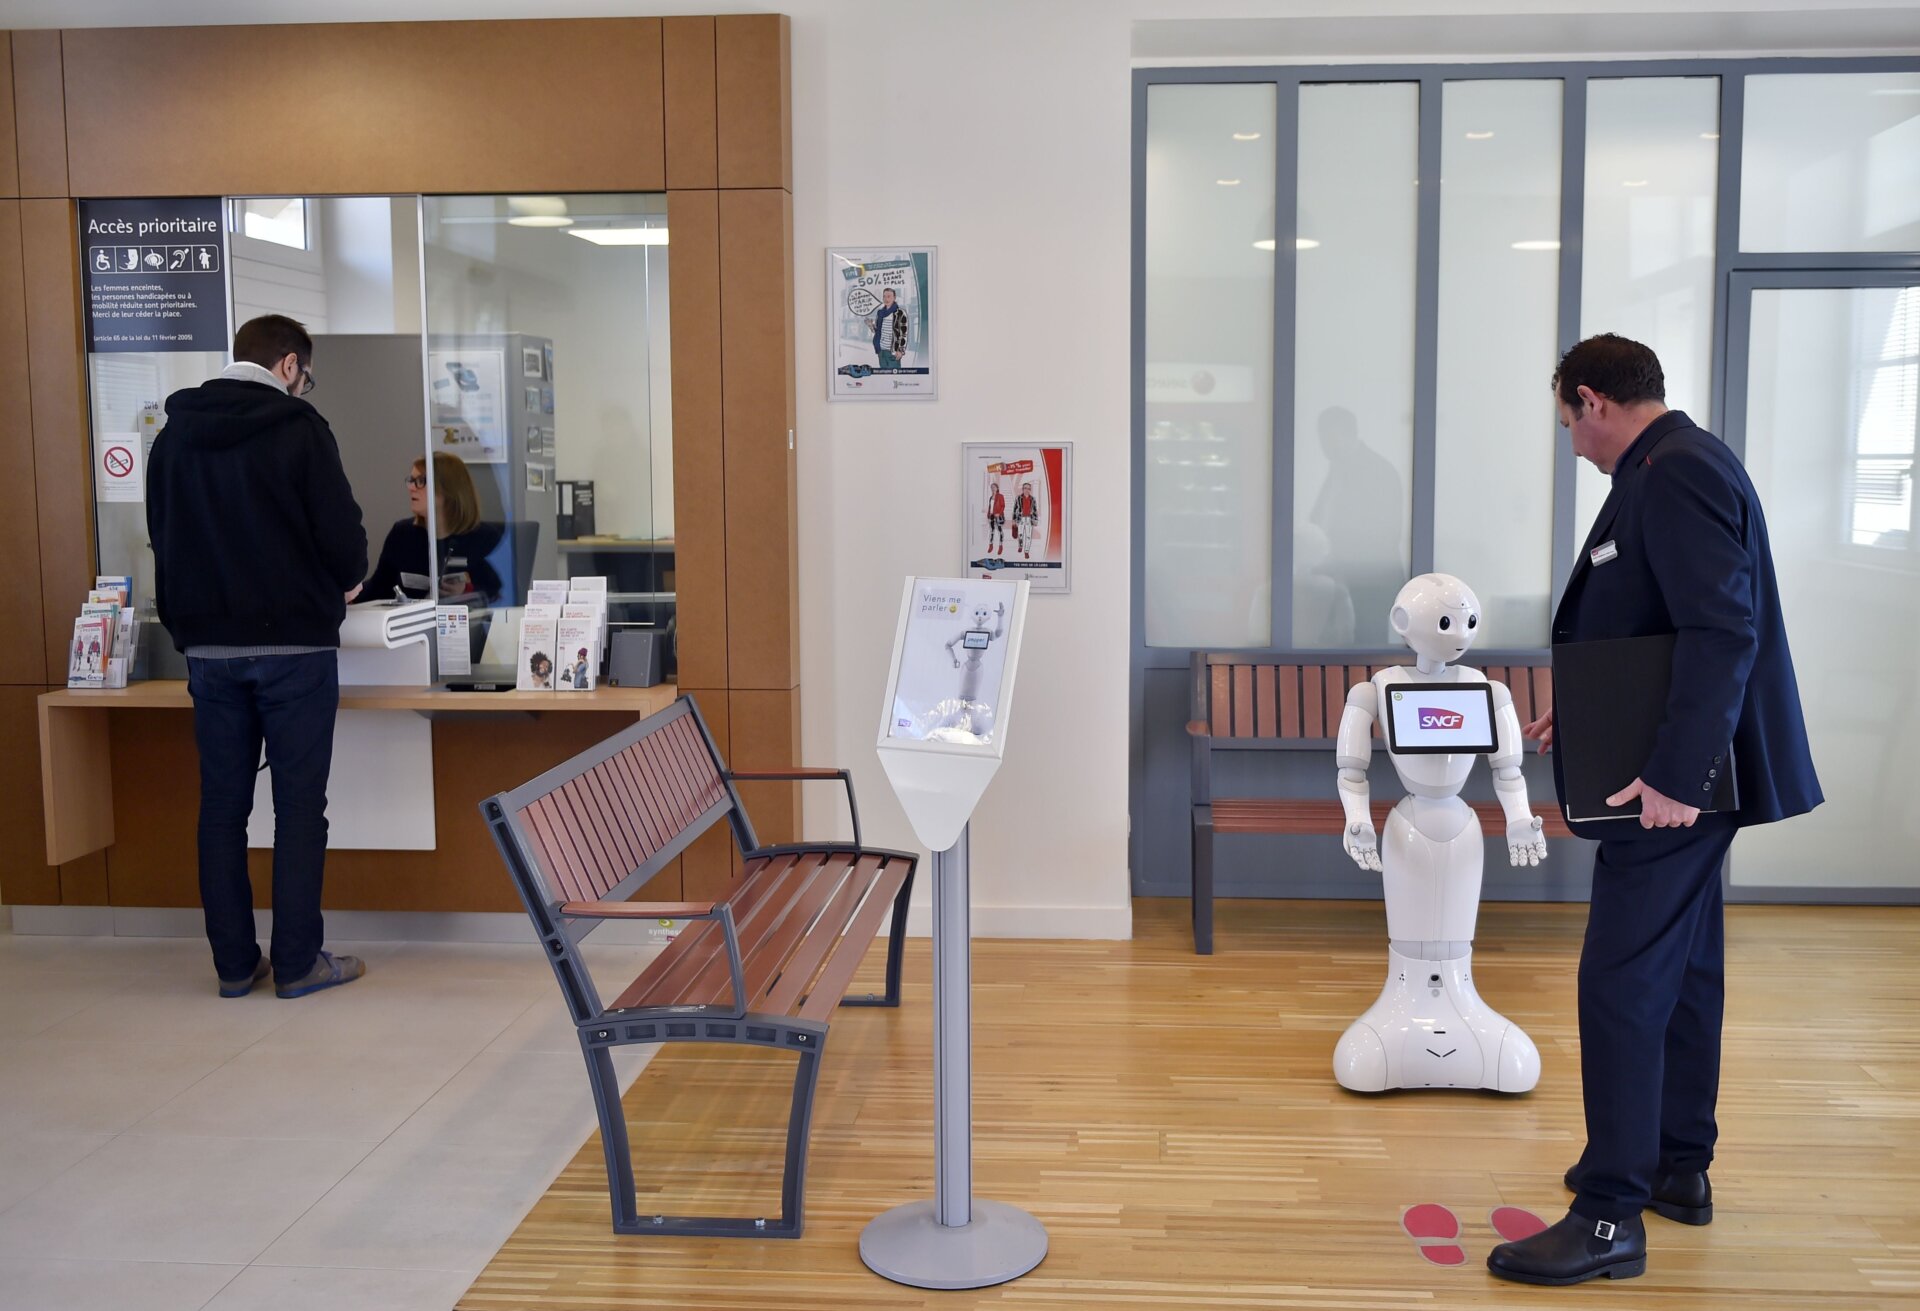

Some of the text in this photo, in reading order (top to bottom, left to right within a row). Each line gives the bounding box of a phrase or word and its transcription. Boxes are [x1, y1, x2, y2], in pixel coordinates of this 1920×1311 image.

[88, 218, 217, 237] Accès prioritaire
[130, 284, 163, 292] enceintes,
[102, 294, 135, 302] personnes
[136, 292, 176, 301] handicapées
[160, 302, 198, 310] prioritaires.
[162, 310, 182, 319] place.
[159, 333, 177, 341] février
[923, 594, 961, 604] Viens me
[921, 604, 947, 613] parler
[1421, 715, 1461, 727] SNCF
